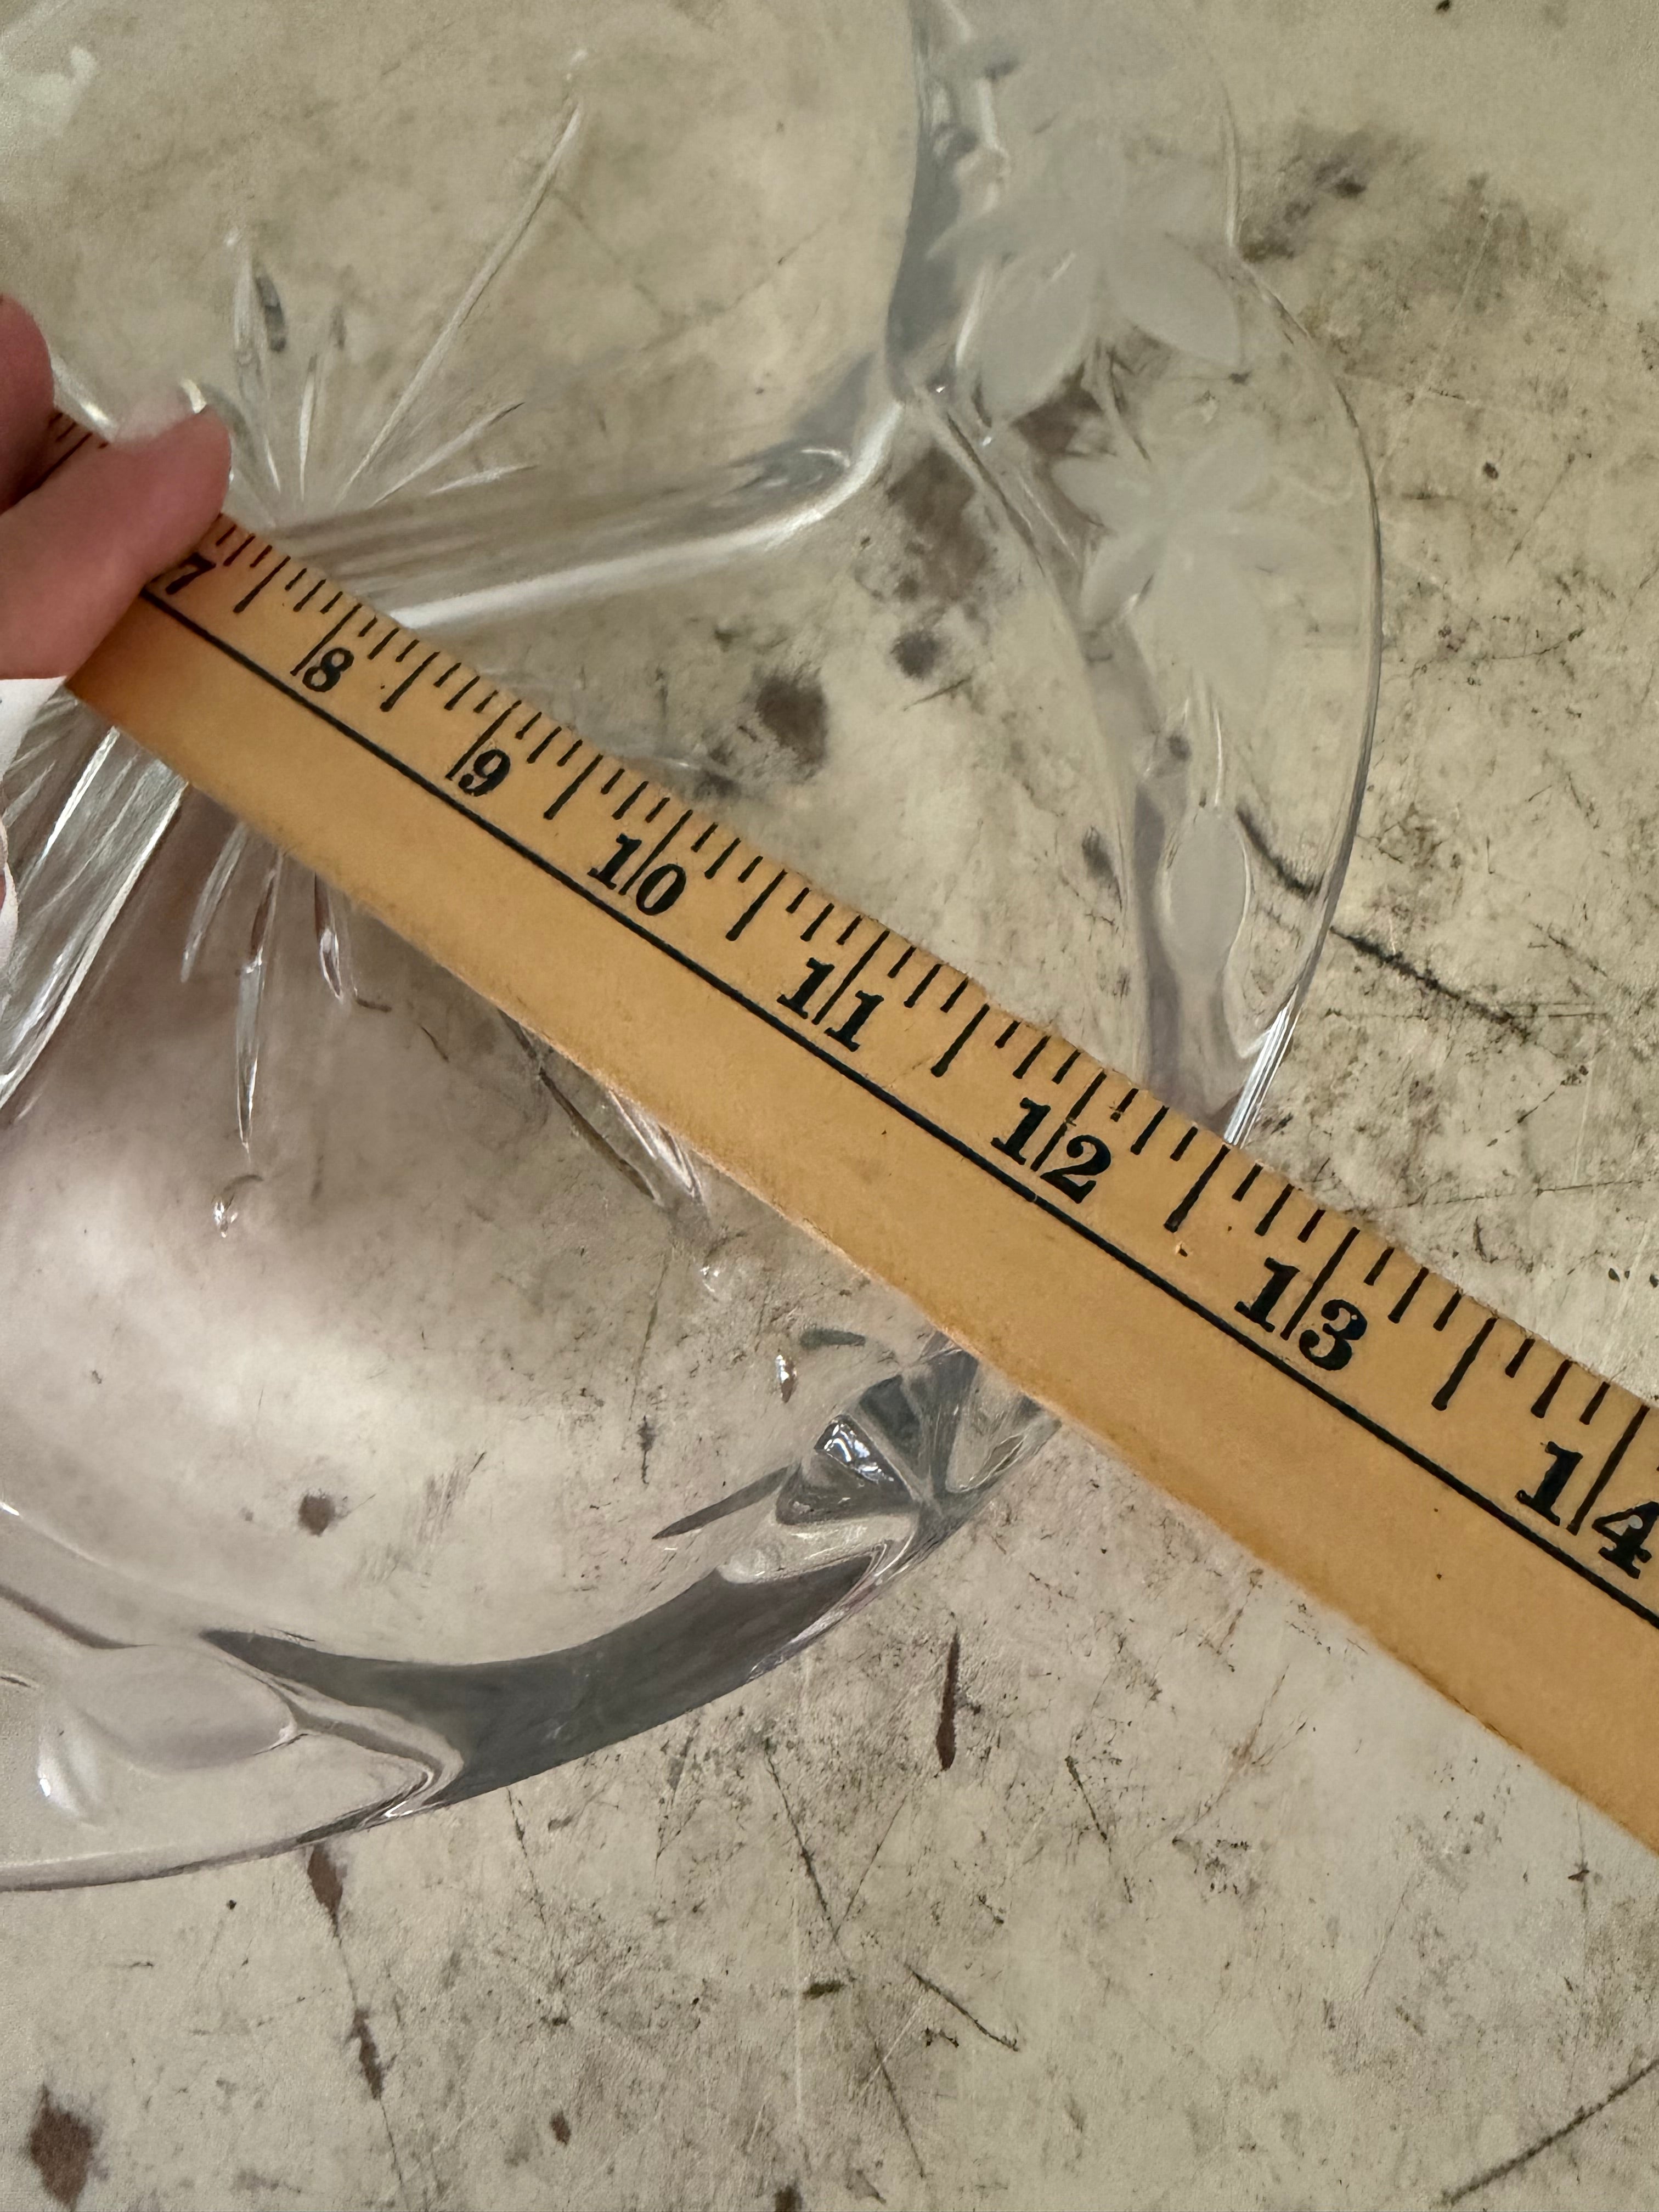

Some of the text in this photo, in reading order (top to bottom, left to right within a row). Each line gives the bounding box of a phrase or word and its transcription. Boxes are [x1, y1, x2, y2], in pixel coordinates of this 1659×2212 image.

[166, 552, 1659, 1579] 7 8 9 10 11 12 13 14
